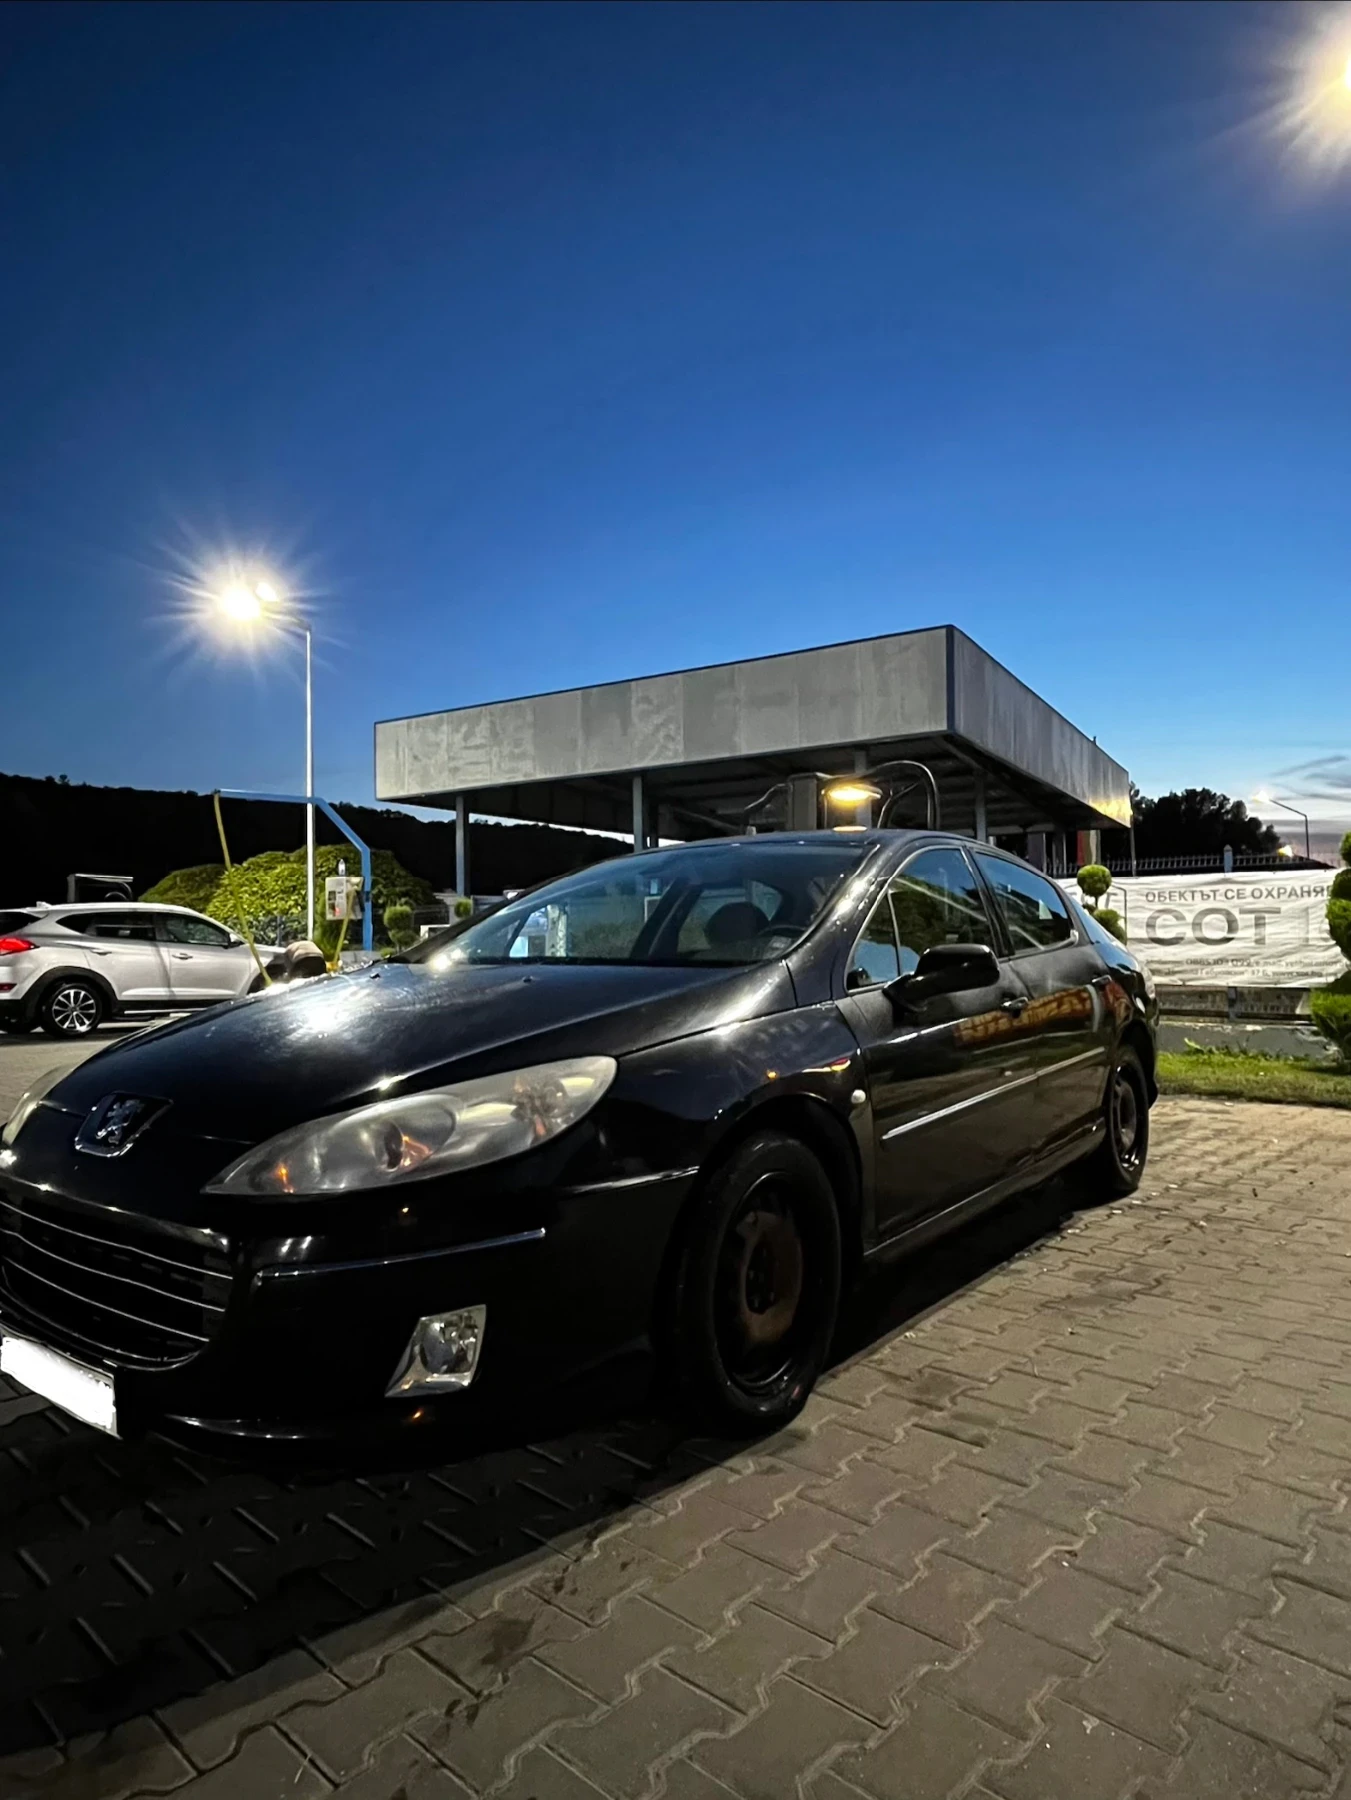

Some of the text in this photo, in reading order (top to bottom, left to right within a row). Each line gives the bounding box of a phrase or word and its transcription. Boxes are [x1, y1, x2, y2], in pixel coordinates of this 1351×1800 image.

[1145, 889, 1219, 903] ОБЕКТЪТ
[1224, 888, 1247, 900] СЕ
[1145, 907, 1282, 947] СОТ
